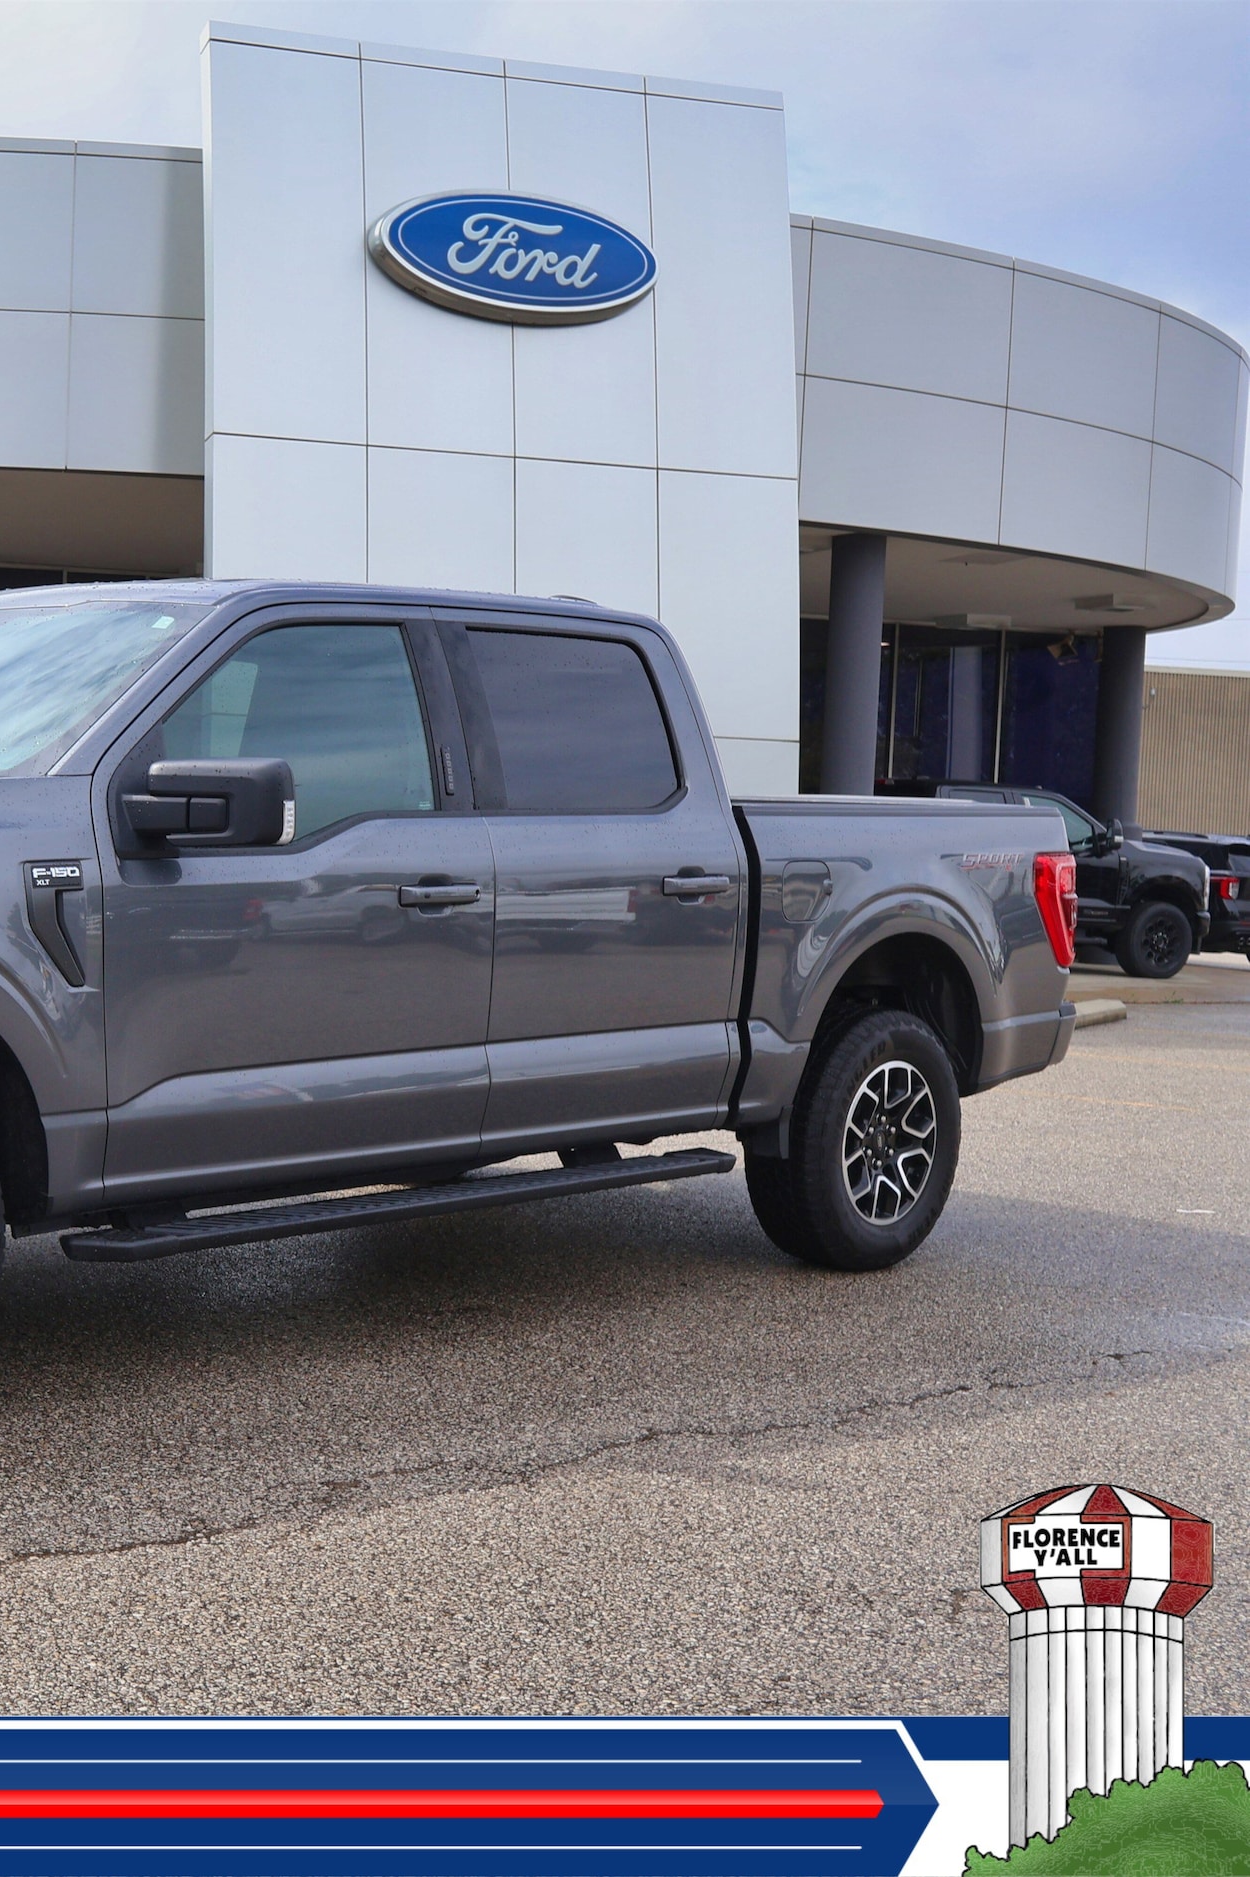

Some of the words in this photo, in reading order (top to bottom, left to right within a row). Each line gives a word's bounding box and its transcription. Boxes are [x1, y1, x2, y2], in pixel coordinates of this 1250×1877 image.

[447, 213, 601, 288] Ford
[959, 852, 1025, 869] SPORT
[32, 866, 80, 878] F-150
